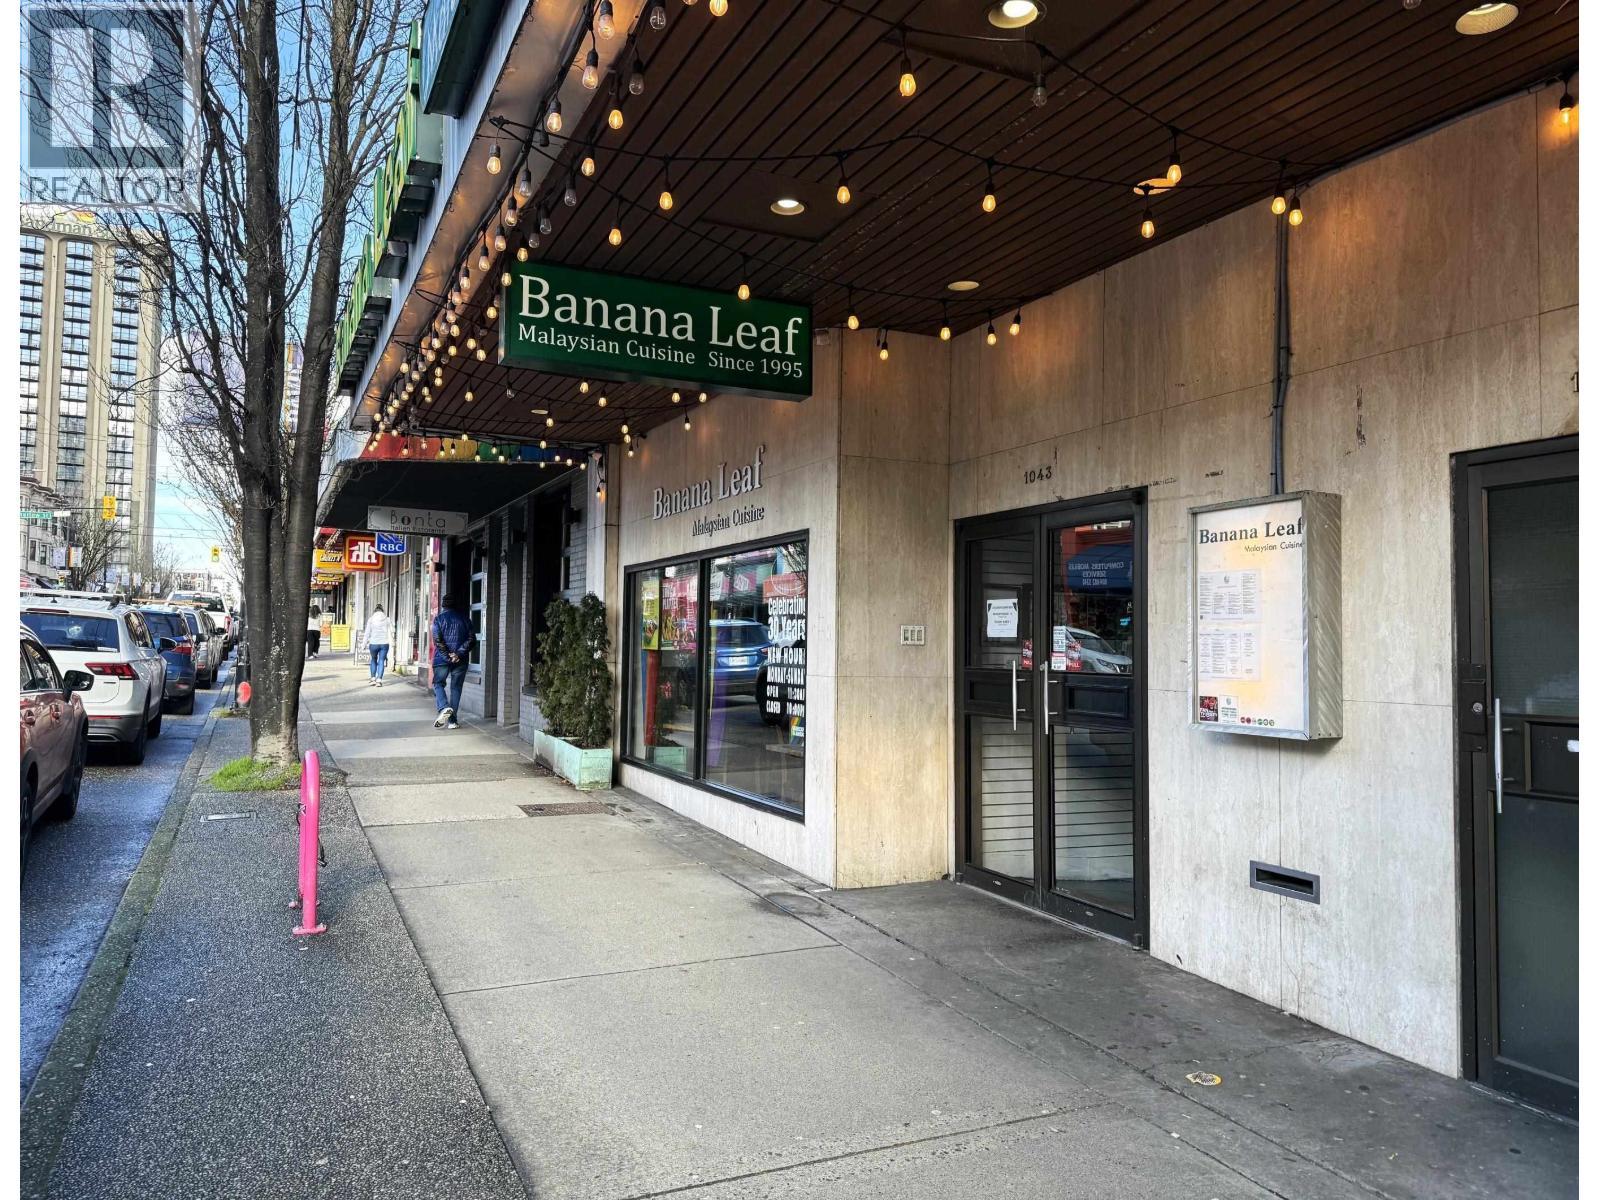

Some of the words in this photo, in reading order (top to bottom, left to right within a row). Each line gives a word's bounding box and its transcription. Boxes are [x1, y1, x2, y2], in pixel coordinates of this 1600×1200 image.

[518, 274, 695, 342] Banana
[709, 305, 802, 356] Leaf
[518, 323, 620, 353] Malaysian
[626, 339, 695, 365] Cuisine
[708, 351, 754, 372] Since
[760, 357, 802, 378] 1995
[653, 479, 713, 520] Banana
[718, 444, 766, 500] Leaf
[1024, 466, 1052, 484] 1043
[692, 514, 730, 537] Malaysian
[732, 504, 765, 527] Cuisine
[1199, 526, 1258, 544] Banana
[1265, 516, 1303, 537] Leaf
[1244, 544, 1277, 552] Malaysian
[768, 617, 779, 641] 30
[768, 647, 781, 663] NEW
[767, 685, 779, 697] OPEN
[766, 700, 780, 713] CLOSED
